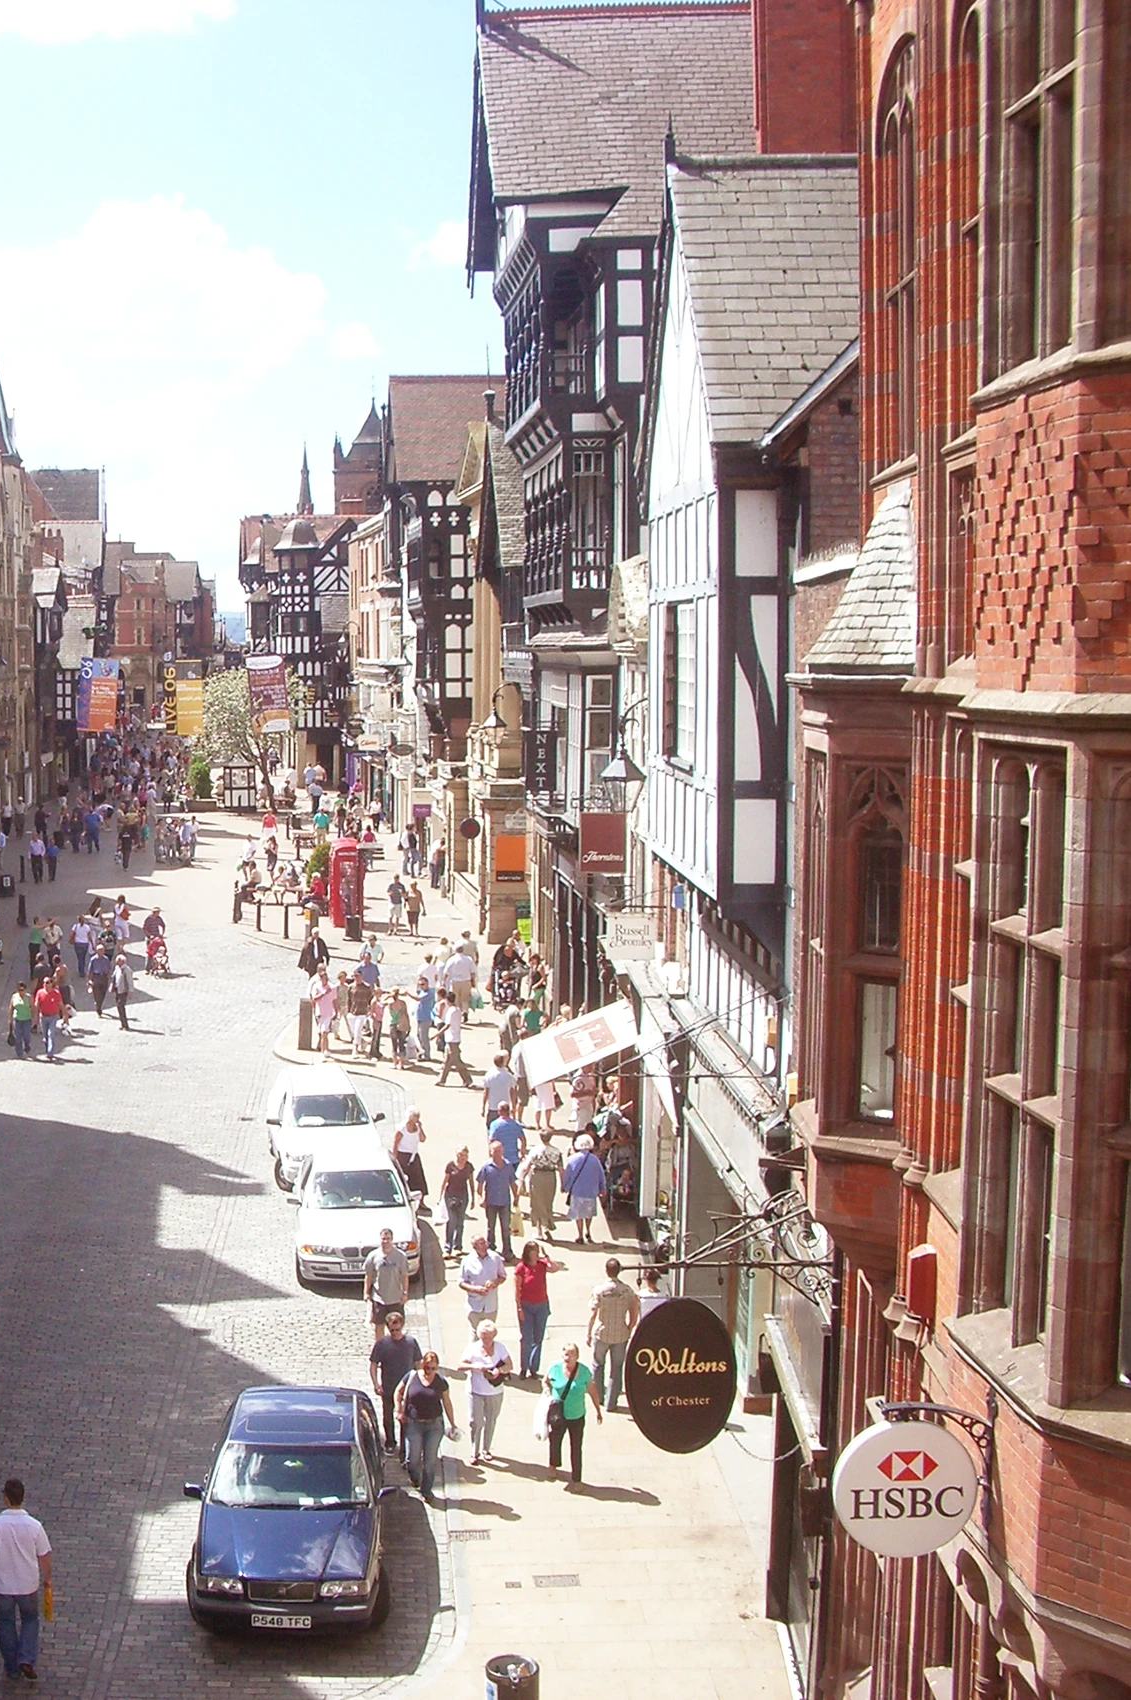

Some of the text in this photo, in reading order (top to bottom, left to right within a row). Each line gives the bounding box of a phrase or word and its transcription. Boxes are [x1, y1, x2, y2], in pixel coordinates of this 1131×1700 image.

[164, 667, 177, 735] LIVE 06
[535, 734, 547, 787] NEXT
[582, 850, 624, 863] Thorntons
[615, 923, 650, 936] Russell
[616, 935, 652, 949] Bromley
[635, 1347, 727, 1375] Waltons
[651, 1396, 710, 1407] of Chester
[850, 1486, 964, 1519] HSBC
[253, 1616, 310, 1627] P548 TFC
